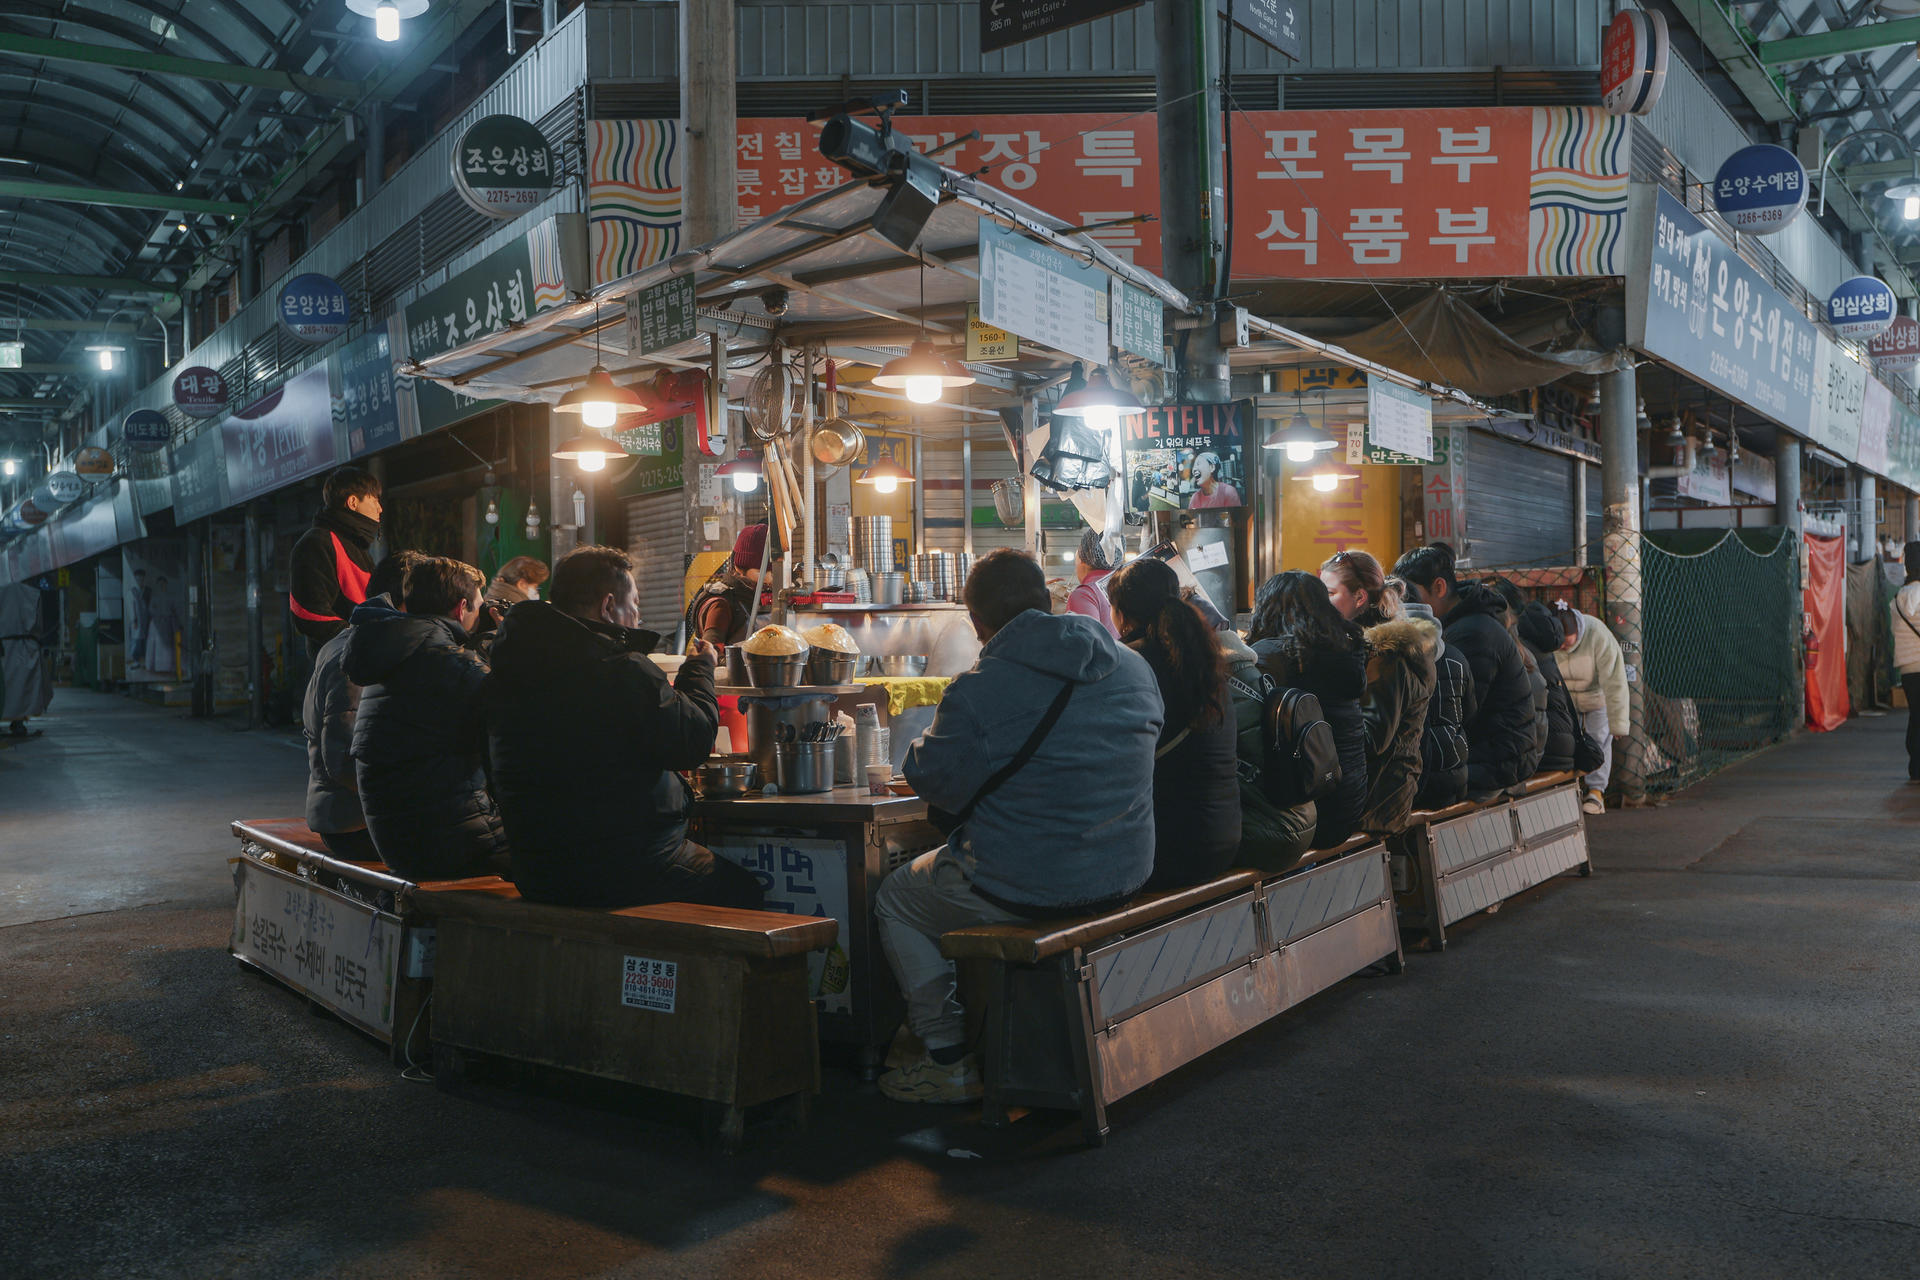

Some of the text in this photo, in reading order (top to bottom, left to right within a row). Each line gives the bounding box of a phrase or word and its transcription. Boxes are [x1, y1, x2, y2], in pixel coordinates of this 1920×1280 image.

[1021, 8, 1040, 20] West
[1042, 3, 1060, 13] Gate
[990, 18, 1003, 31] 285
[466, 146, 549, 177] 조은상회
[1257, 126, 1498, 184] 포목부
[1719, 171, 1799, 198] 온양수예점
[486, 190, 539, 203] 2275-2697
[1737, 209, 1783, 225] 2266-6369
[1255, 206, 1497, 266] 식품부
[285, 295, 345, 316] 온양상회
[1113, 301, 1121, 317] 70
[1831, 292, 1890, 318] 일심상회
[1712, 260, 1795, 382] 온양수예점
[979, 332, 1006, 342] 1560-1
[180, 375, 222, 395] 대광
[1126, 404, 1239, 441] NETFLIX
[1350, 439, 1360, 448] 70
[294, 936, 326, 986] 수제비
